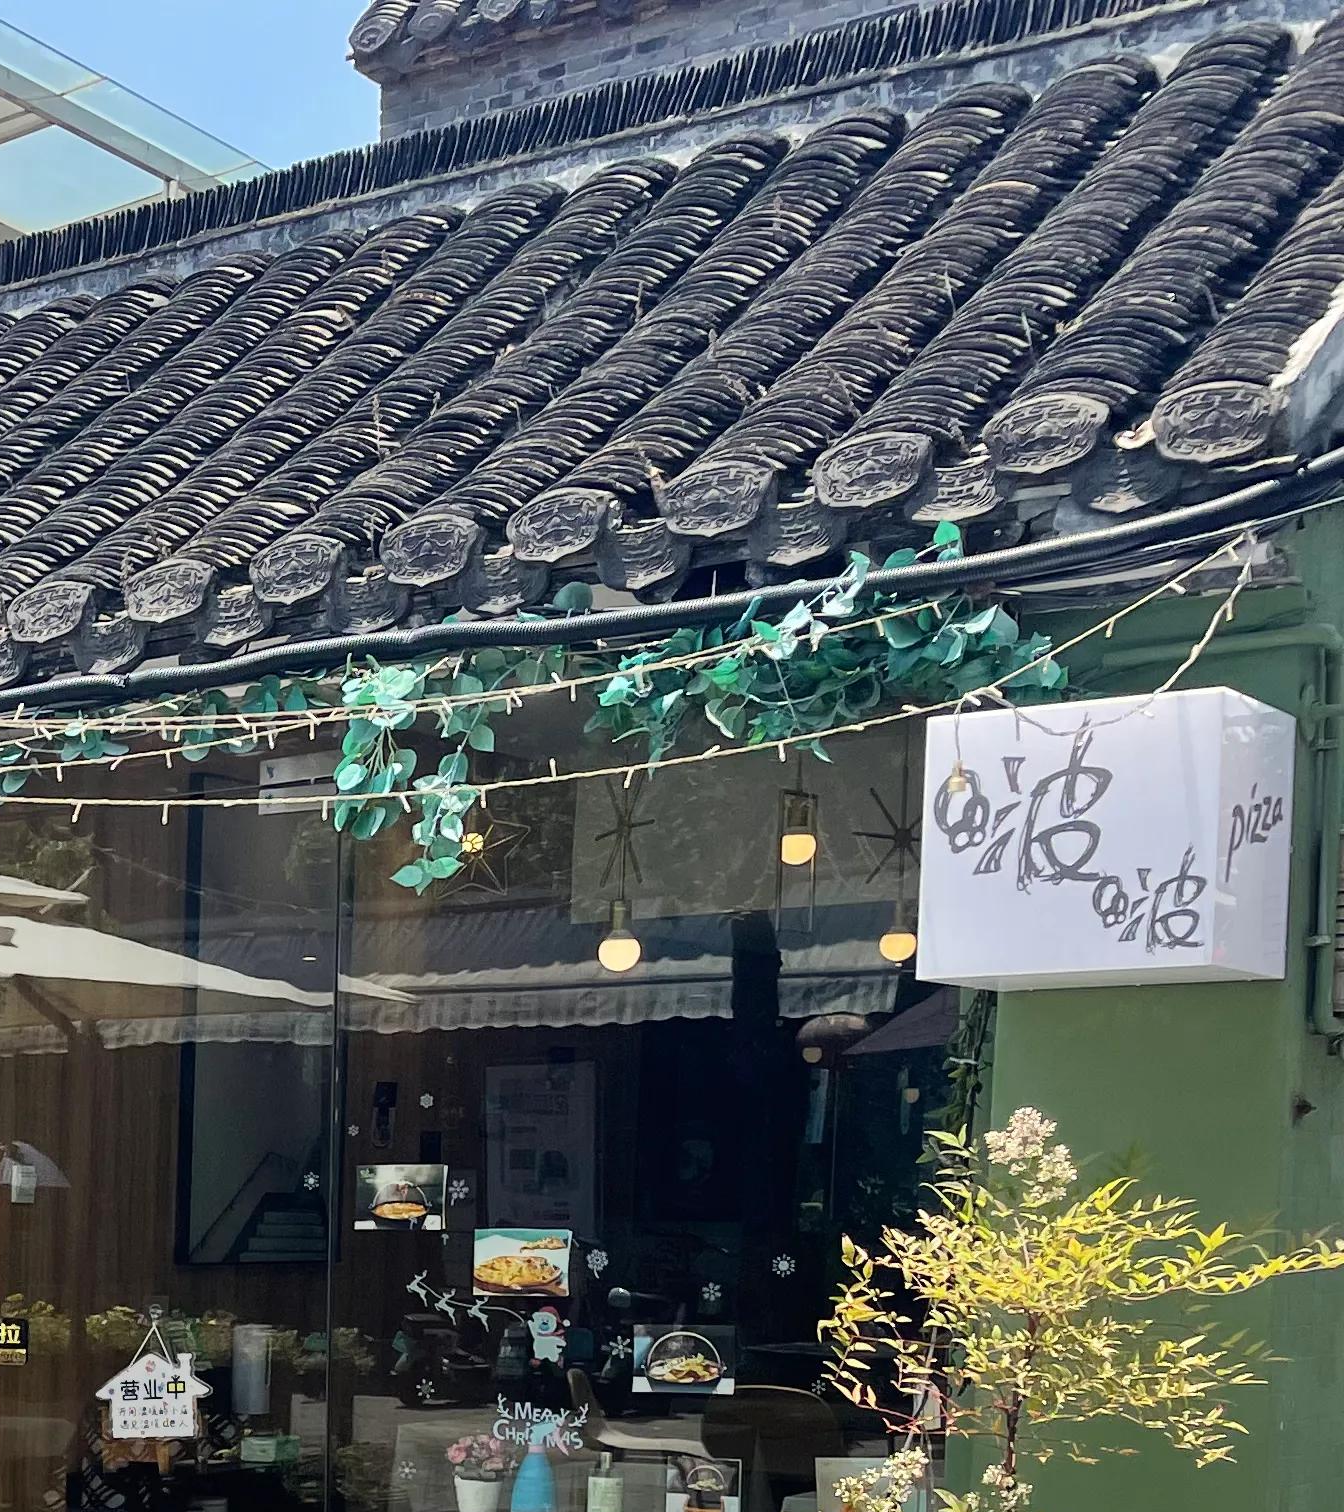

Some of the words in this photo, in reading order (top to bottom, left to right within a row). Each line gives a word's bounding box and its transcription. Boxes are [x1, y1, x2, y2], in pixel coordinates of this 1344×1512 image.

[1225, 782, 1283, 883] pizza
[120, 1375, 186, 1401] 营业中
